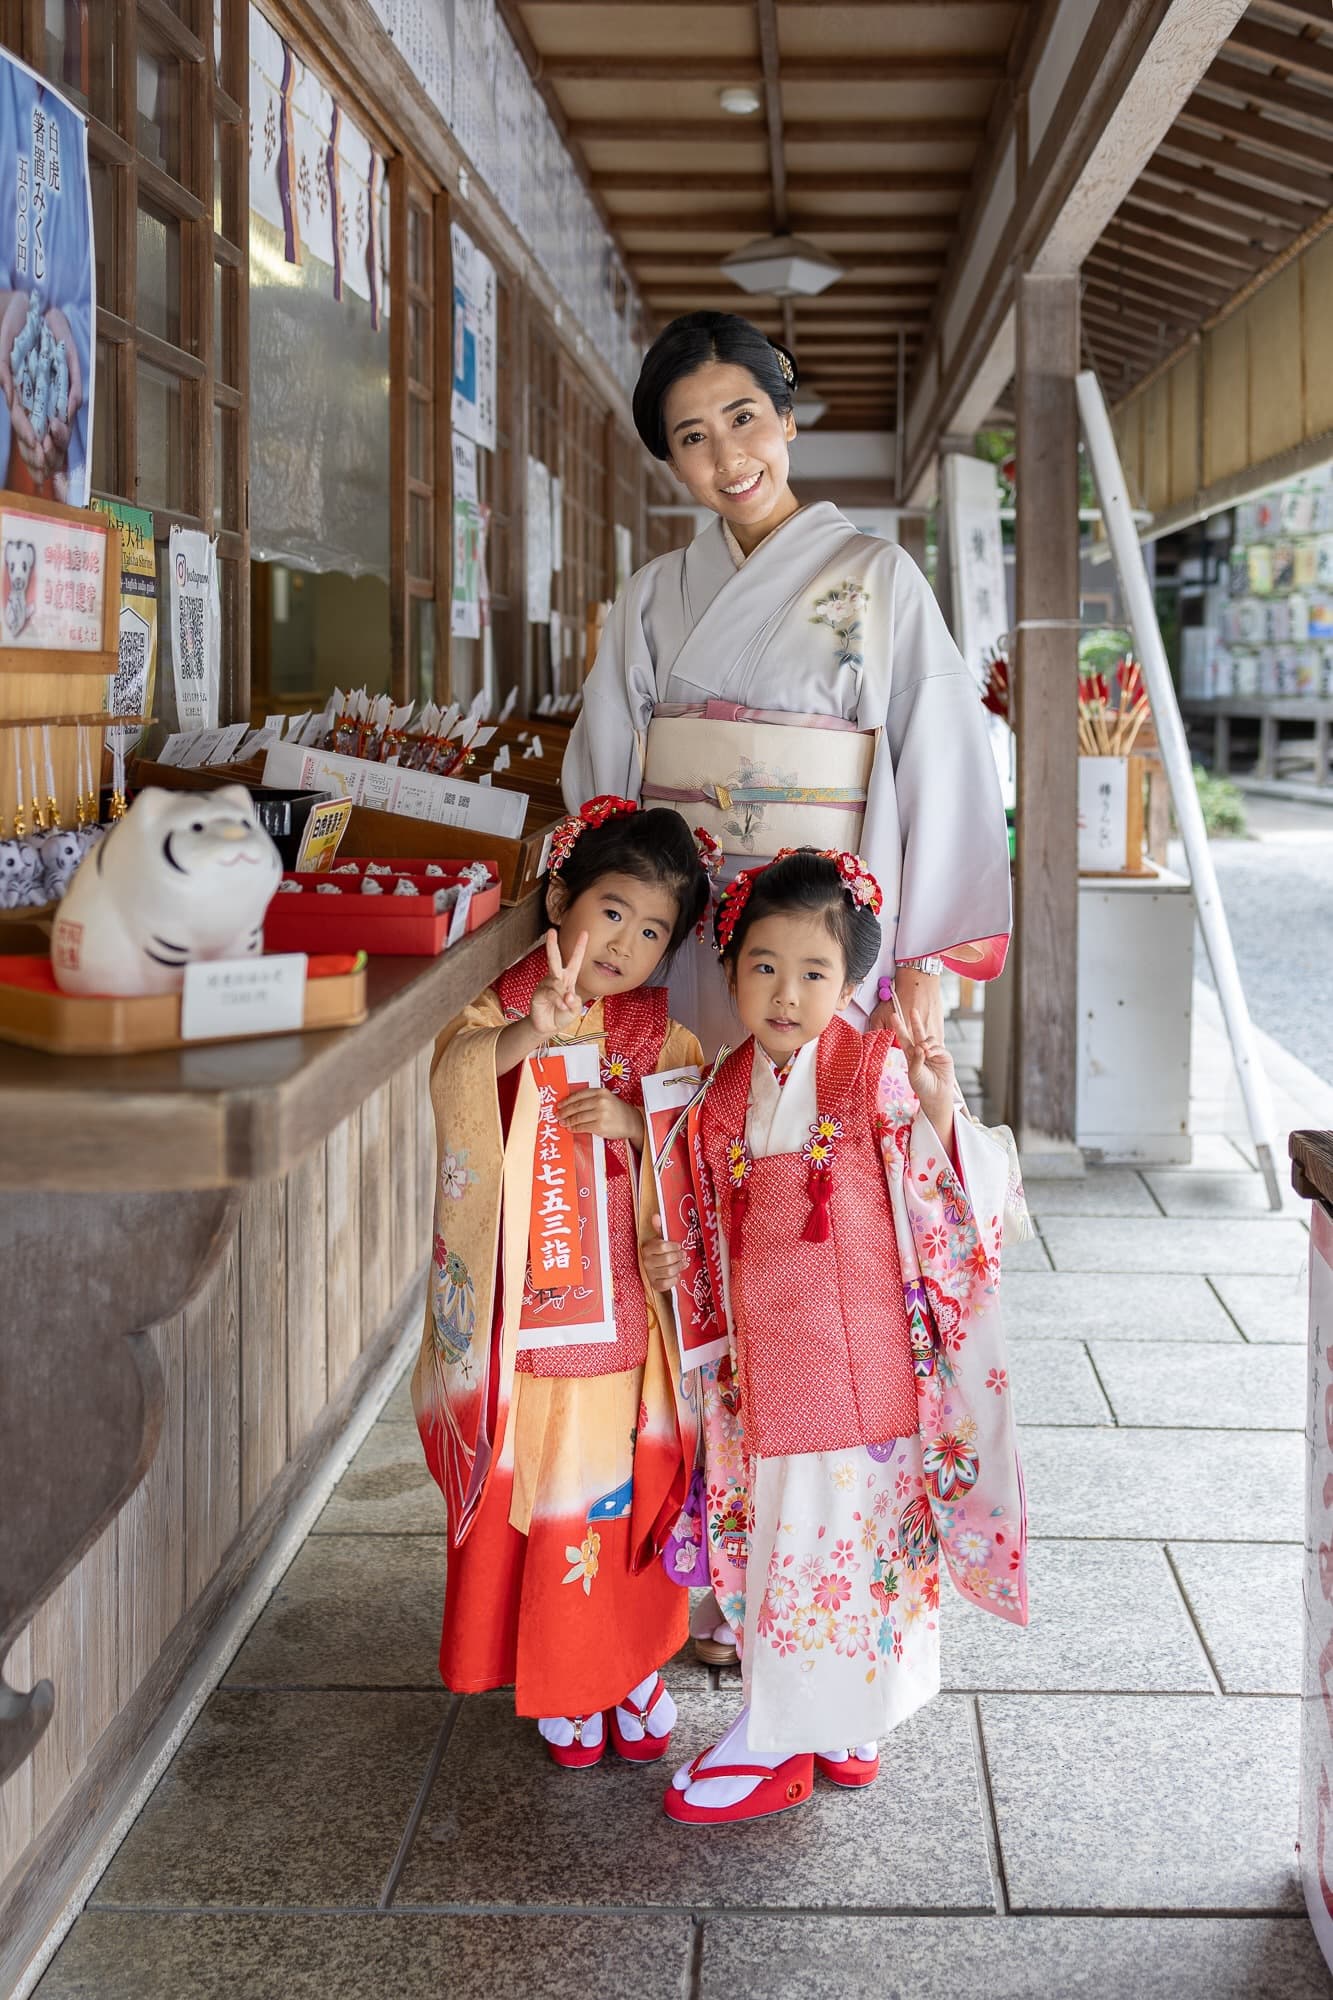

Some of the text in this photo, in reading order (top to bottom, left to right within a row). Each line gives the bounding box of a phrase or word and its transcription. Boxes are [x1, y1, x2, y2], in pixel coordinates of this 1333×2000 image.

[33, 108, 46, 279] 箸置みくじ
[49, 122, 60, 191] 白虎
[187, 567, 209, 589] Instagram
[535, 1085, 572, 1271] 松尾大社七五三詣
